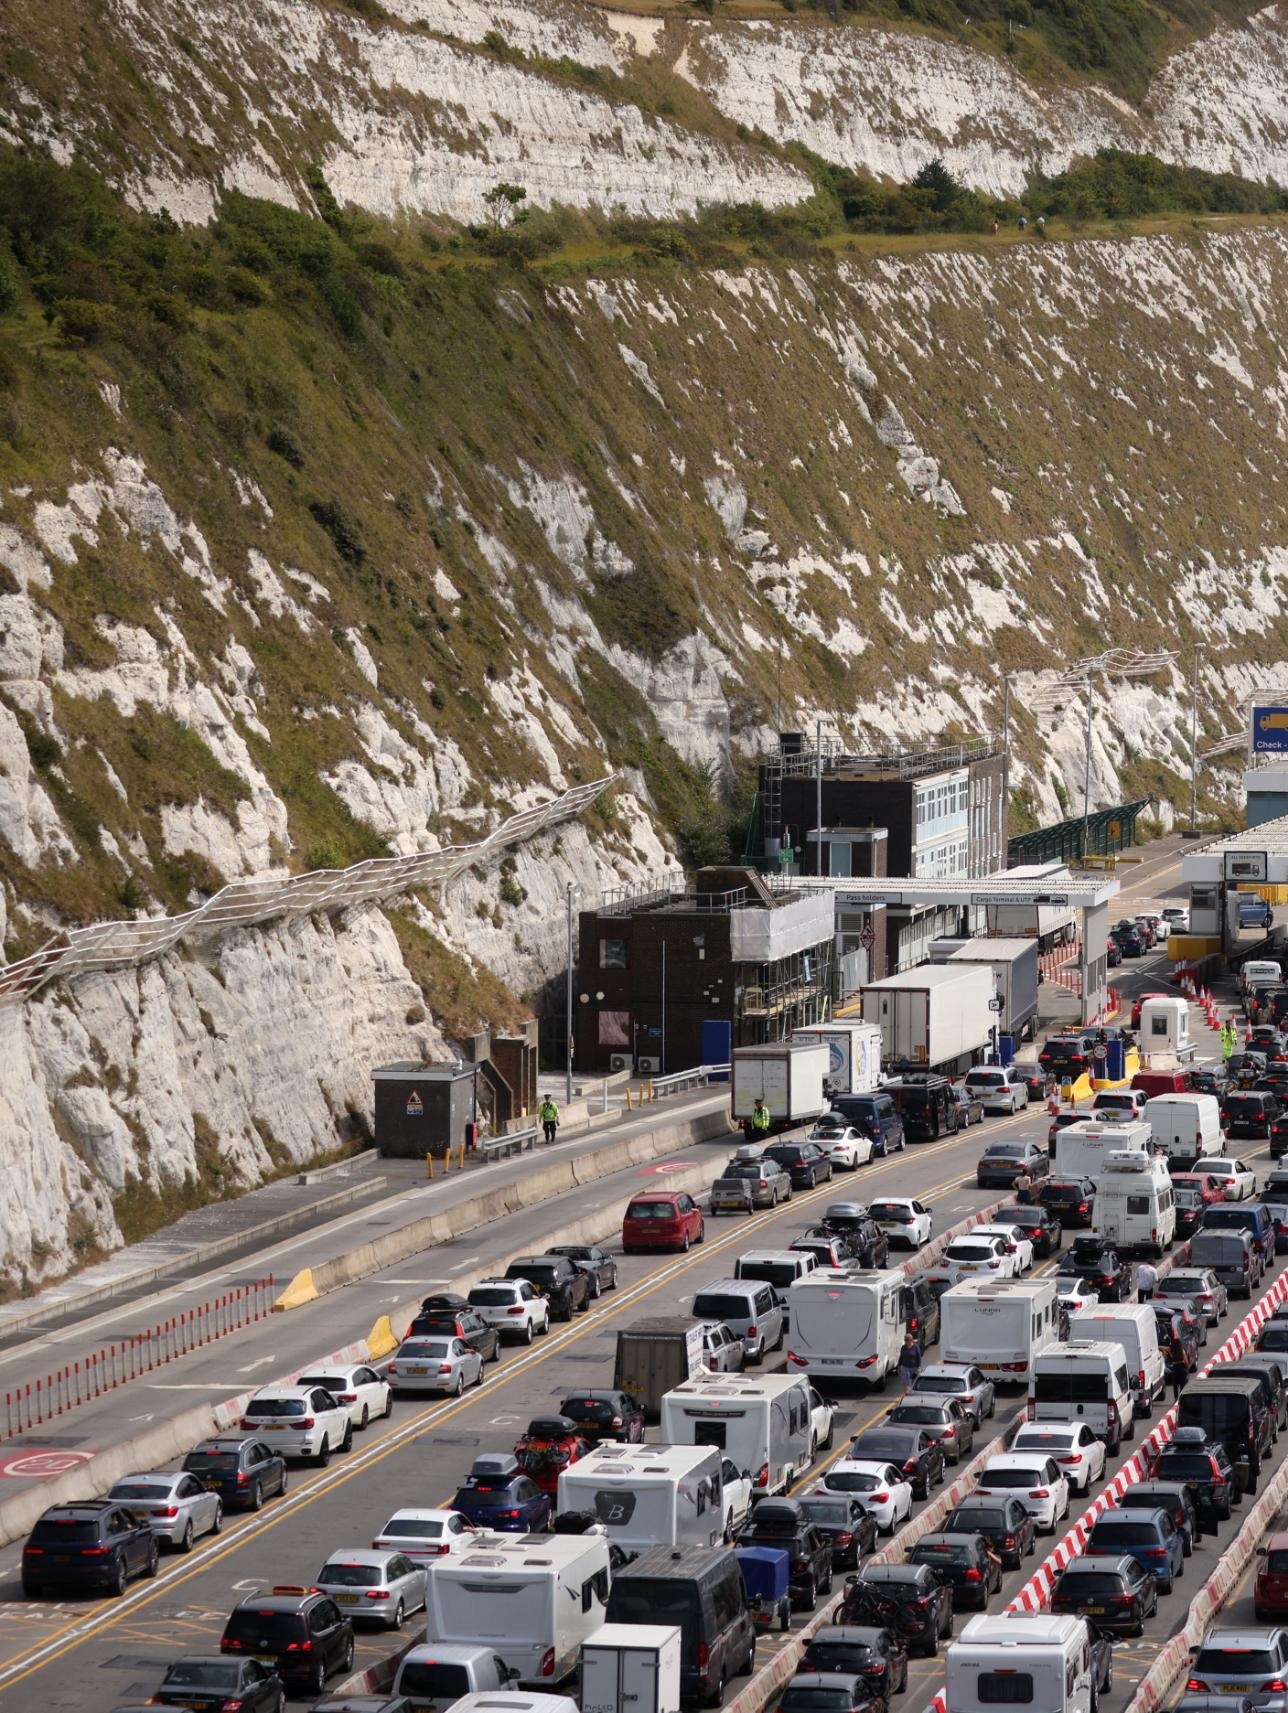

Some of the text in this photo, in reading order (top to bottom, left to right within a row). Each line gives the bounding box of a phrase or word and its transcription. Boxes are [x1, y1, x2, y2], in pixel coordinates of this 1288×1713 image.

[1256, 740, 1281, 749] Check
[976, 896, 992, 904] Cargo
[608, 1504, 625, 1520] B
